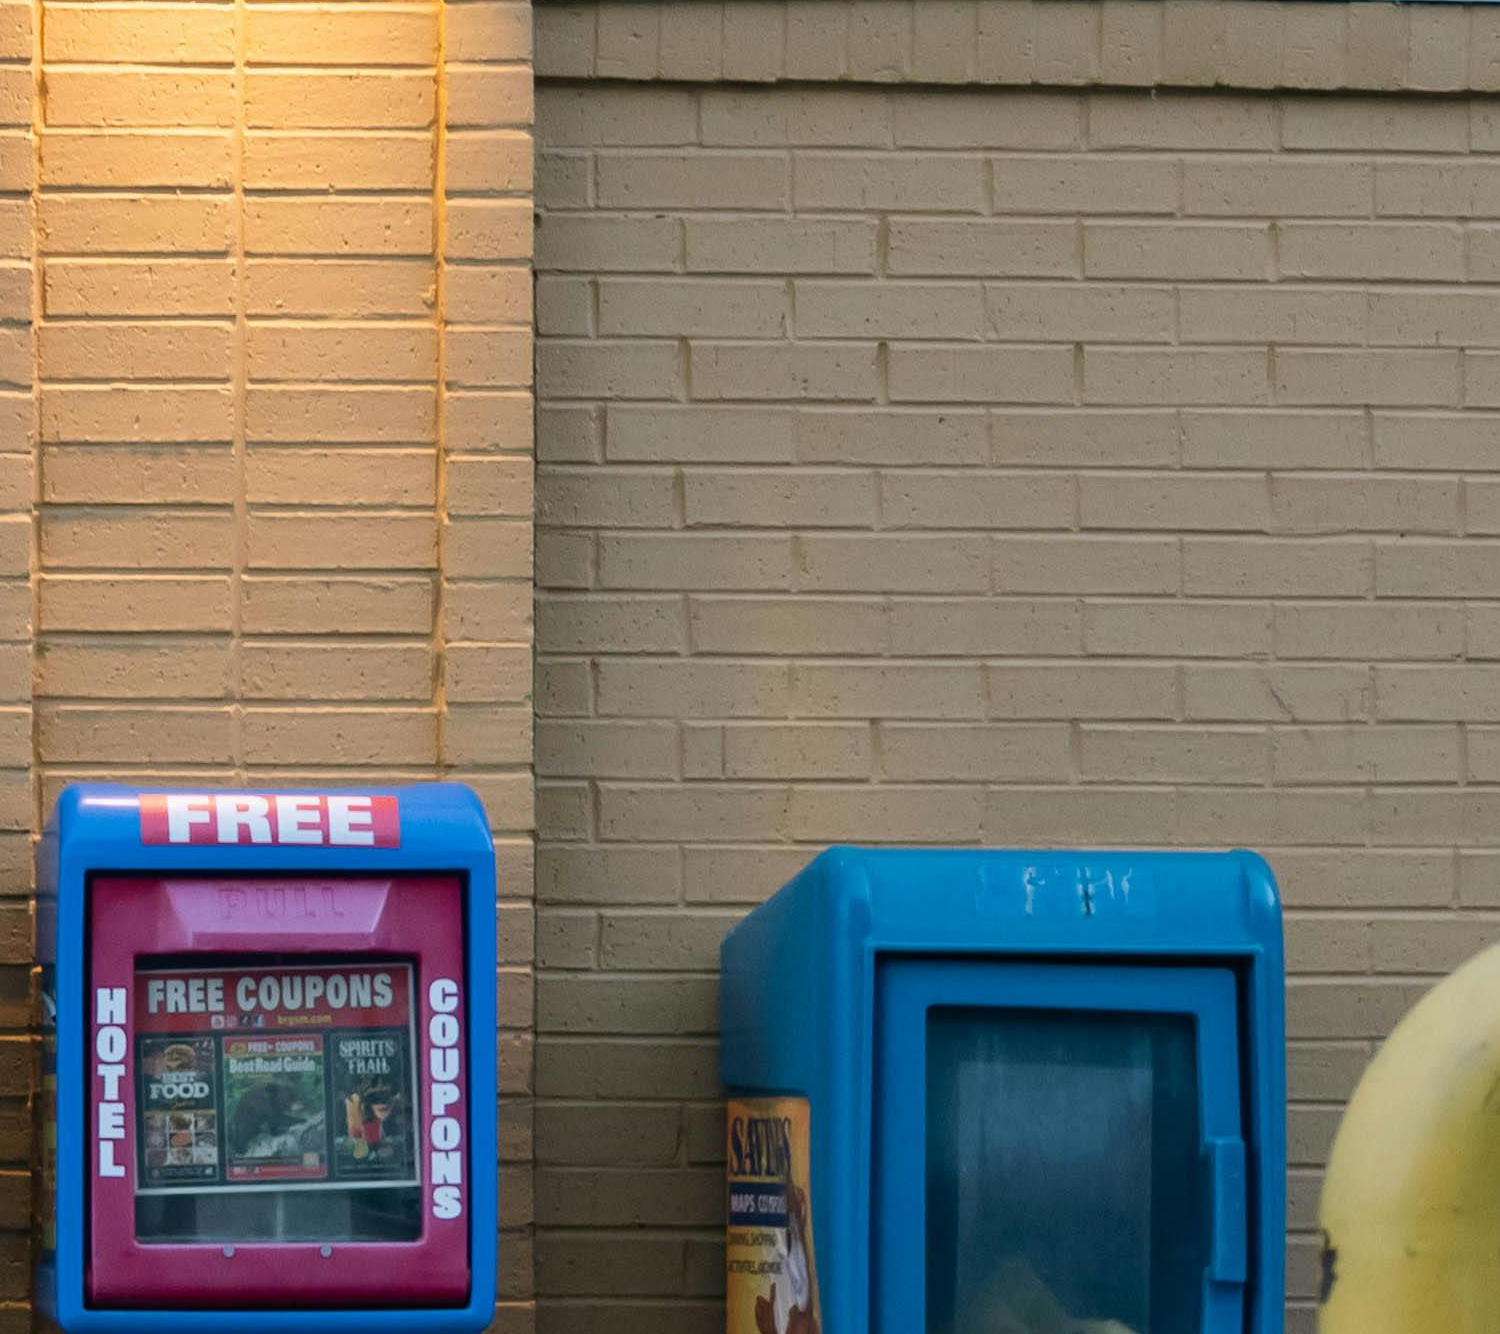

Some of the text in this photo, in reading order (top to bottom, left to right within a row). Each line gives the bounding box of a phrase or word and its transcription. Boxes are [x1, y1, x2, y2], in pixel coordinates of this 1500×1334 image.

[167, 794, 375, 846] FREE
[217, 886, 345, 919] PULL
[148, 973, 393, 1013] FREE COUPONS
[339, 1039, 394, 1058] SPIRITS
[96, 987, 127, 1178] HOTEL
[149, 1082, 209, 1099] FOOD
[429, 978, 462, 1220] COUPONS
